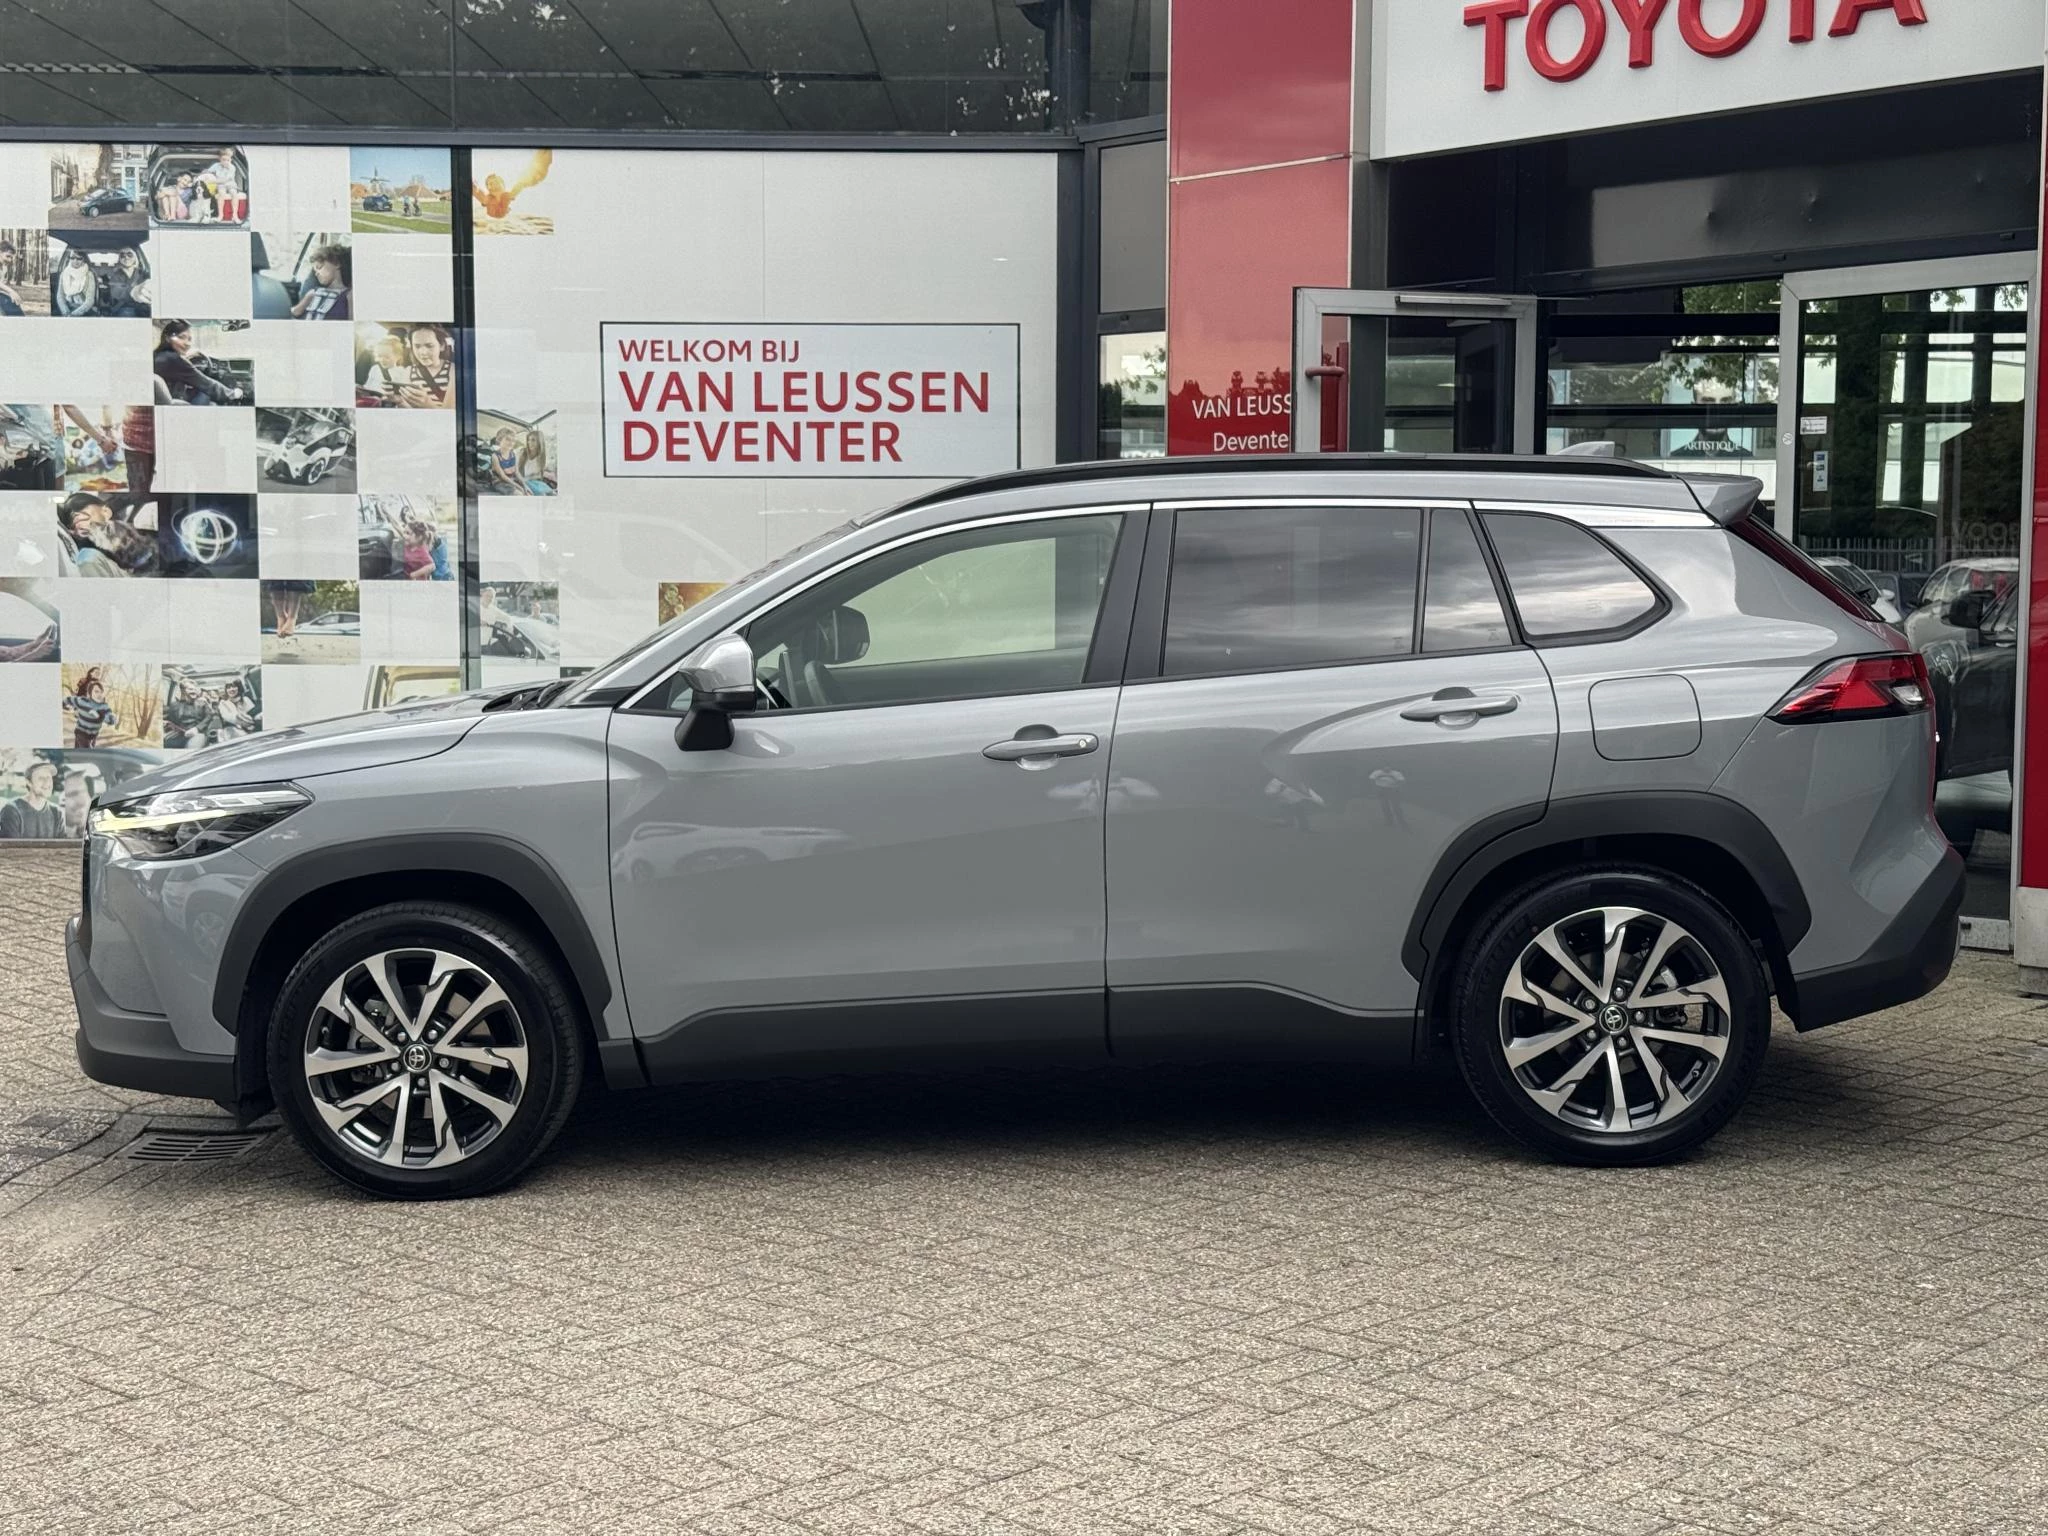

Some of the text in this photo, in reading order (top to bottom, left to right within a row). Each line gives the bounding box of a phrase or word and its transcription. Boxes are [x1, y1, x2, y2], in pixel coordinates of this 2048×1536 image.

[618, 339, 800, 363] WELKOM BIJ
[618, 371, 990, 414] VAN LEUSSEN
[1191, 397, 1232, 419] VAN
[623, 420, 904, 463] DEVENTER
[1684, 440, 1742, 453] ARTISTIQUE
